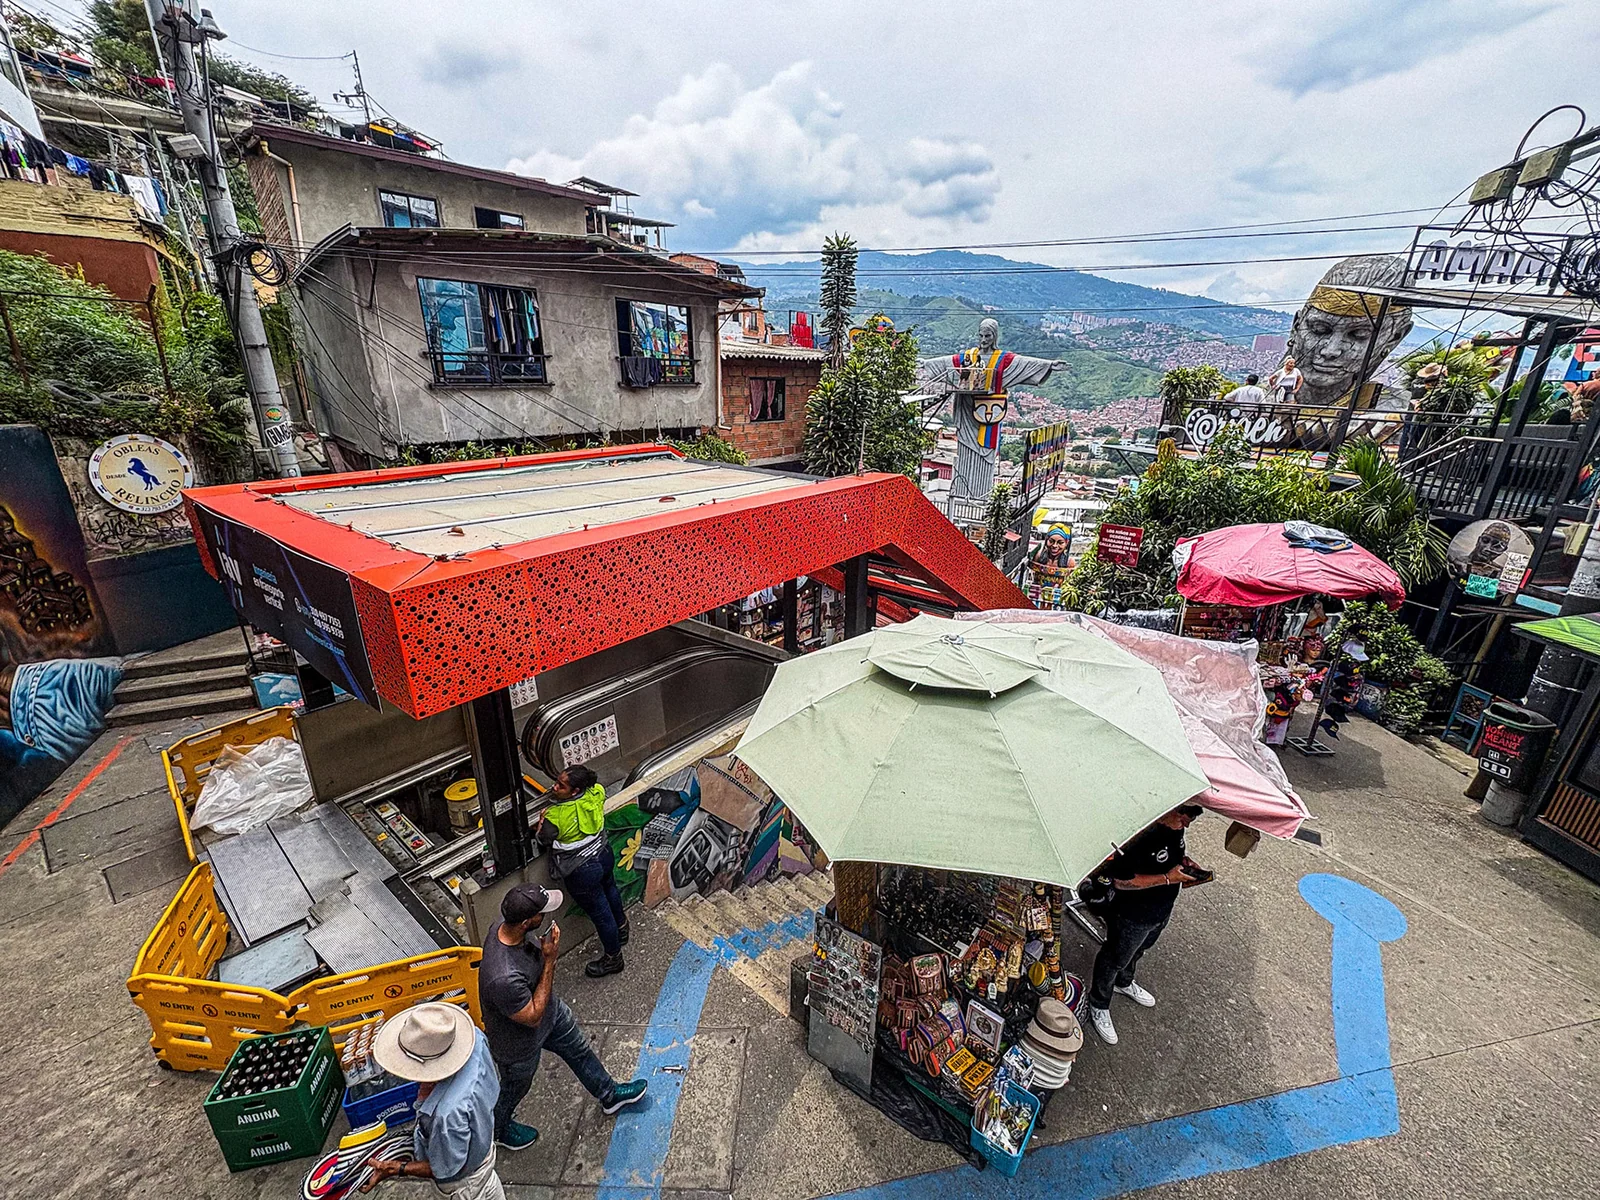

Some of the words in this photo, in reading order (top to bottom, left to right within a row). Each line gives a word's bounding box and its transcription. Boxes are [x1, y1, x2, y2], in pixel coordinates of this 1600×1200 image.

[113, 445, 160, 458] OBLEAS
[114, 479, 181, 505] RELINCHO
[1485, 725, 1524, 743] JOHNNY
[157, 959, 165, 971] NO
[164, 939, 176, 960] ENTRY
[411, 982, 425, 990] NO
[426, 974, 453, 986] ENTRY
[172, 1002, 195, 1011] ENTRY
[330, 1002, 345, 1010] NO
[346, 994, 375, 1006] ENTRY
[238, 1011, 261, 1020] ENTRY
[310, 1055, 329, 1095] ANDINA
[320, 1088, 339, 1128] ANDINA
[237, 1108, 280, 1126] ANDINA
[250, 1141, 292, 1158] ANDINA
